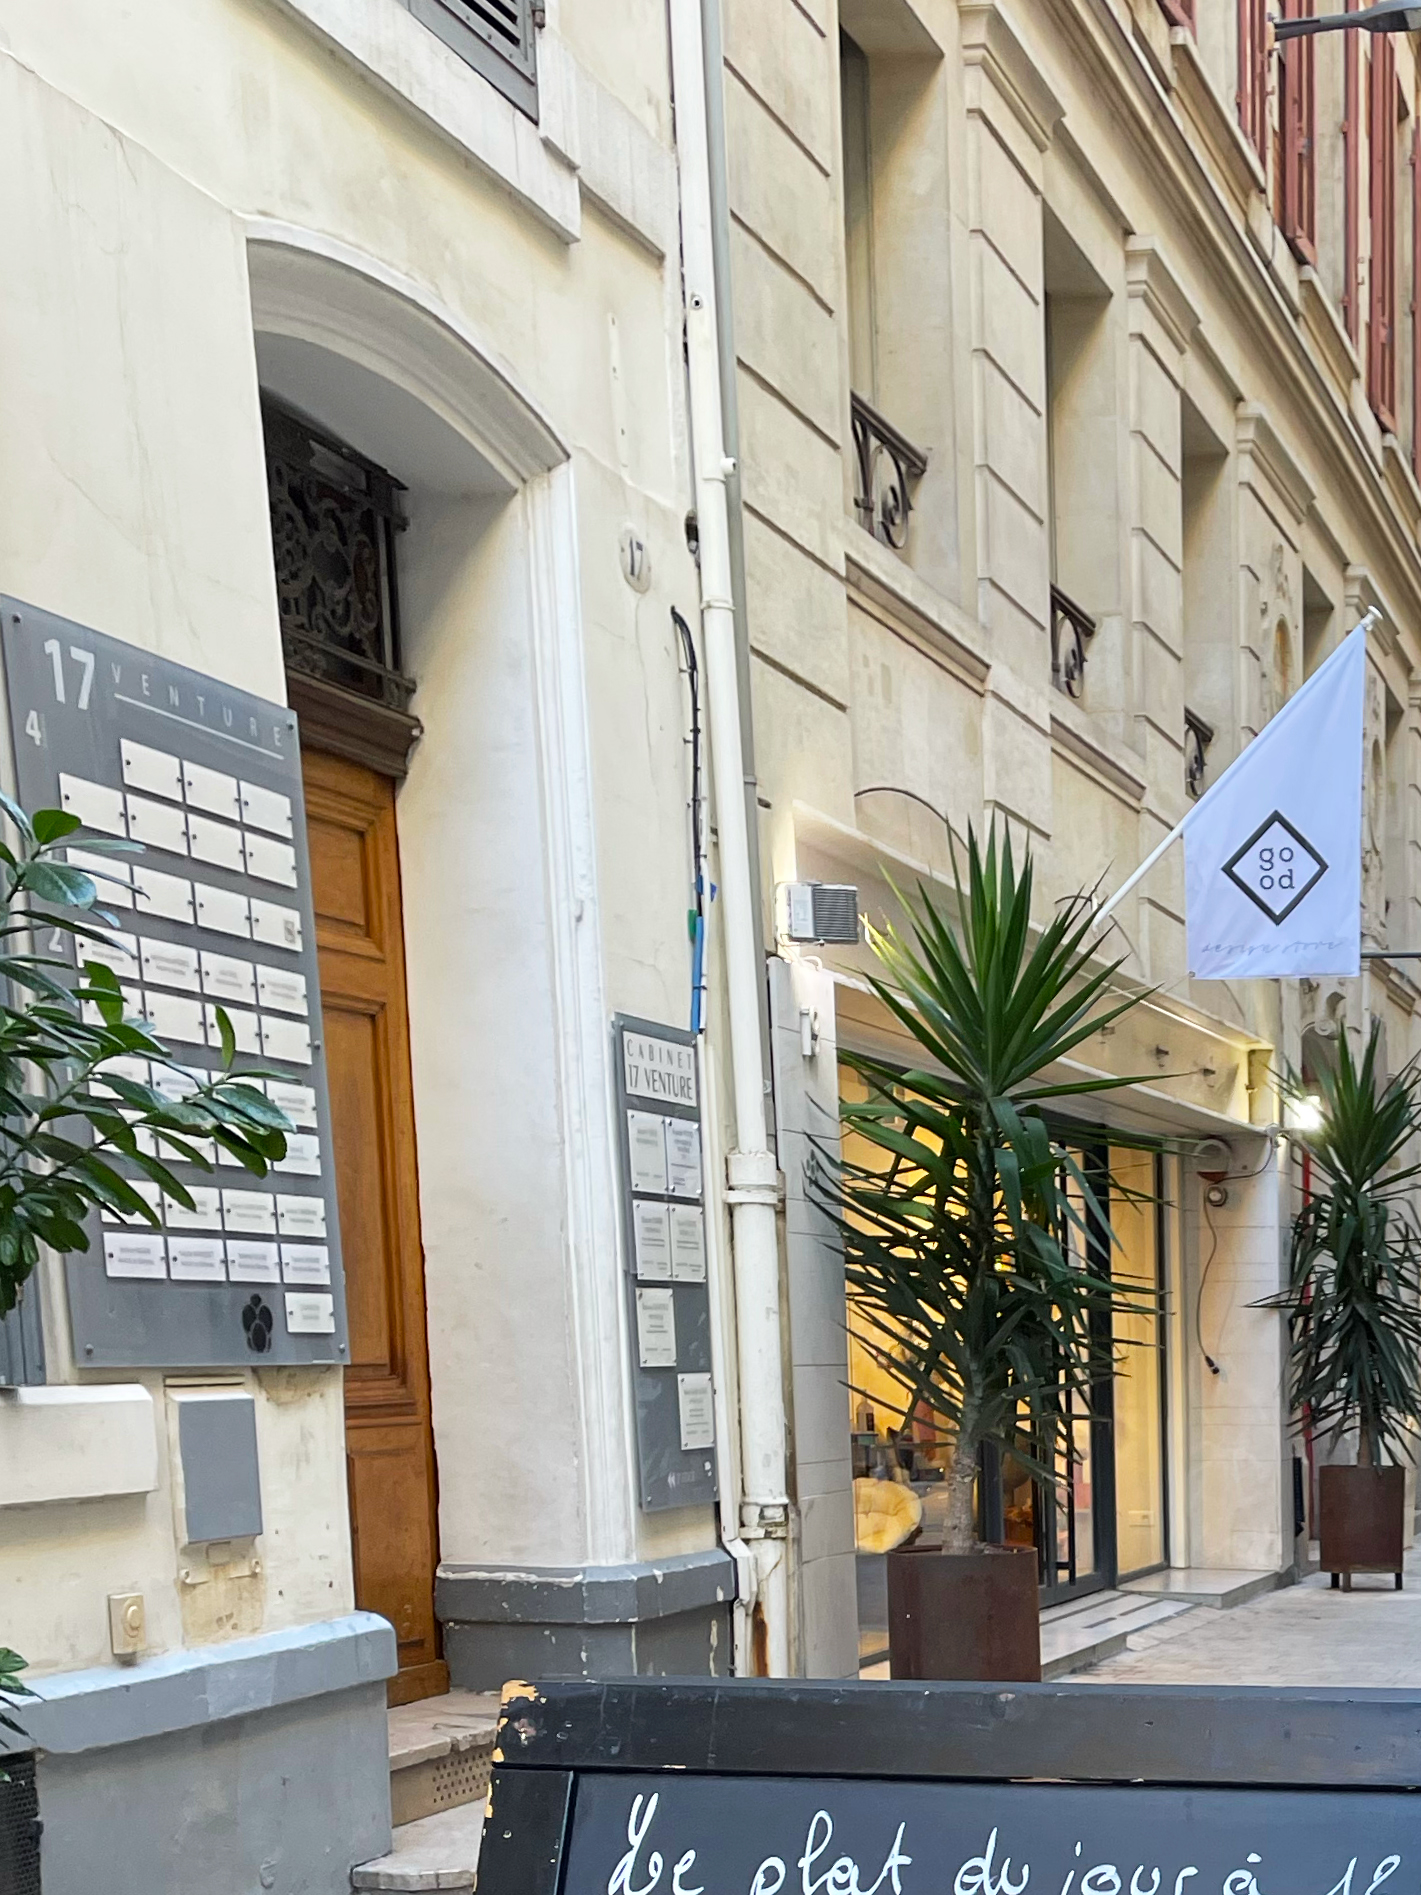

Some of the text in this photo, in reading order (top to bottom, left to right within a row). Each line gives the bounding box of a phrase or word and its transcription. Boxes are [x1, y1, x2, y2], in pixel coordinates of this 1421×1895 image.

[44, 638, 284, 748] 17 VENTURE
[25, 710, 42, 746] 4
[626, 1038, 692, 1070] CABINET
[628, 1064, 693, 1101] 17 VENTURE
